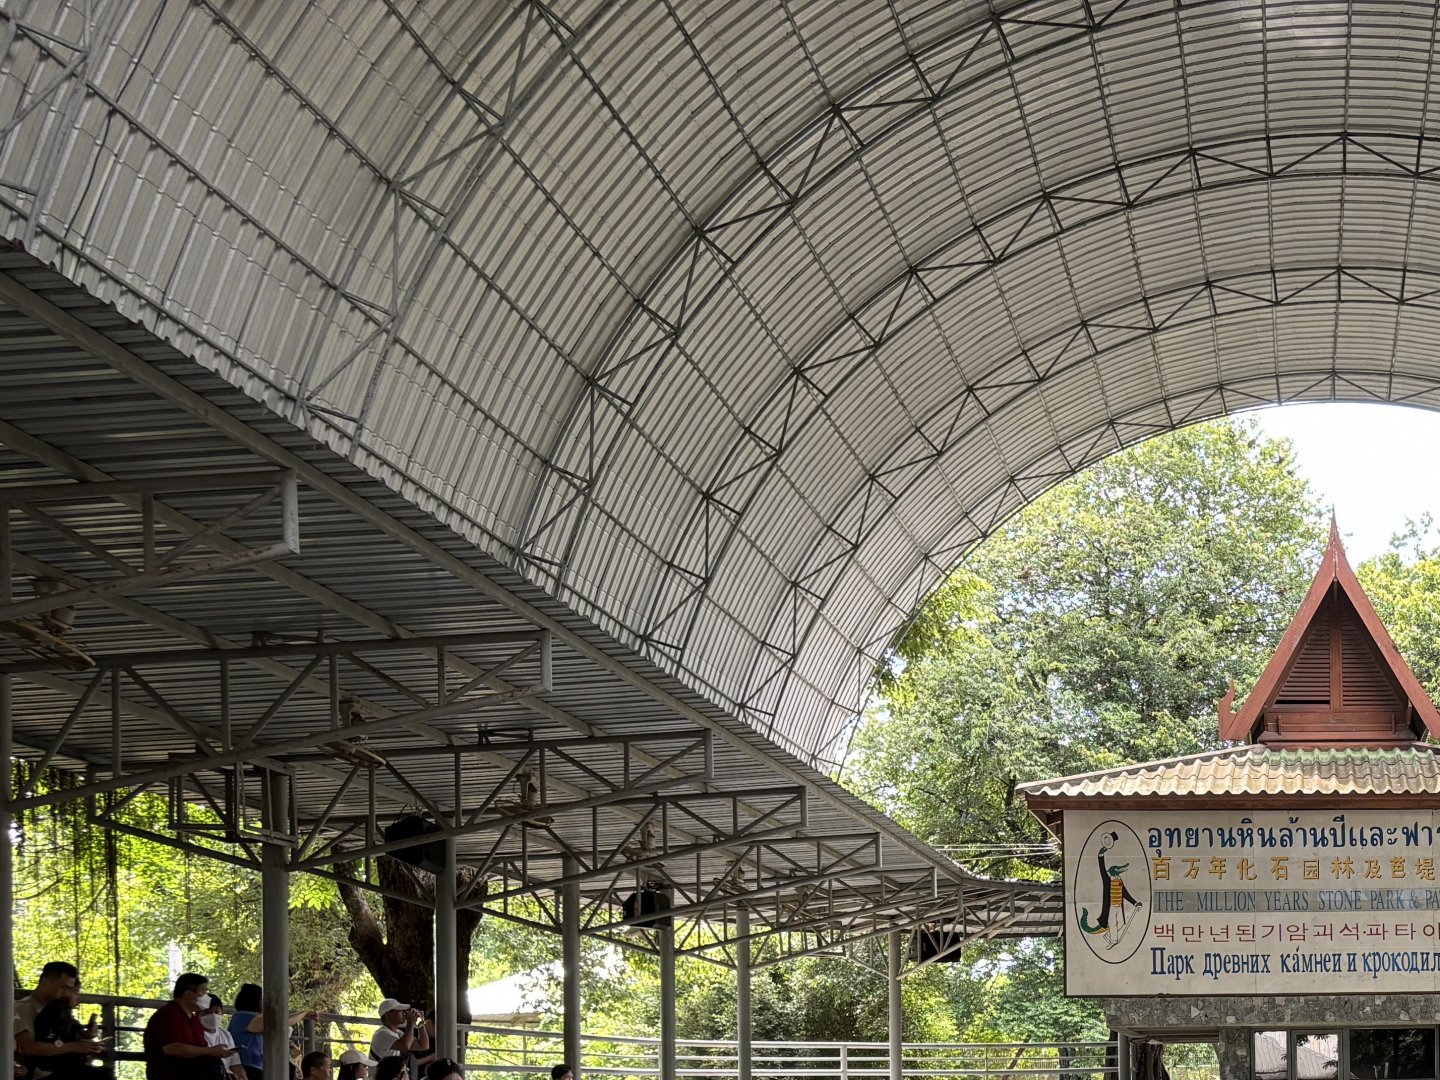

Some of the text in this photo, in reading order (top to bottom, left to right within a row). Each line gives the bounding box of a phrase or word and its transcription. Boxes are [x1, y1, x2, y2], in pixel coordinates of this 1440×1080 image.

[1154, 891, 1184, 911] THE
[1199, 890, 1256, 911] MILLION
[1265, 890, 1309, 911] YEARS
[1318, 890, 1362, 910] STONE
[1370, 889, 1405, 909] PARK
[1409, 889, 1419, 909] &
[1151, 947, 1195, 979] Парк
[1203, 951, 1271, 979] древних
[1346, 952, 1357, 973] и
